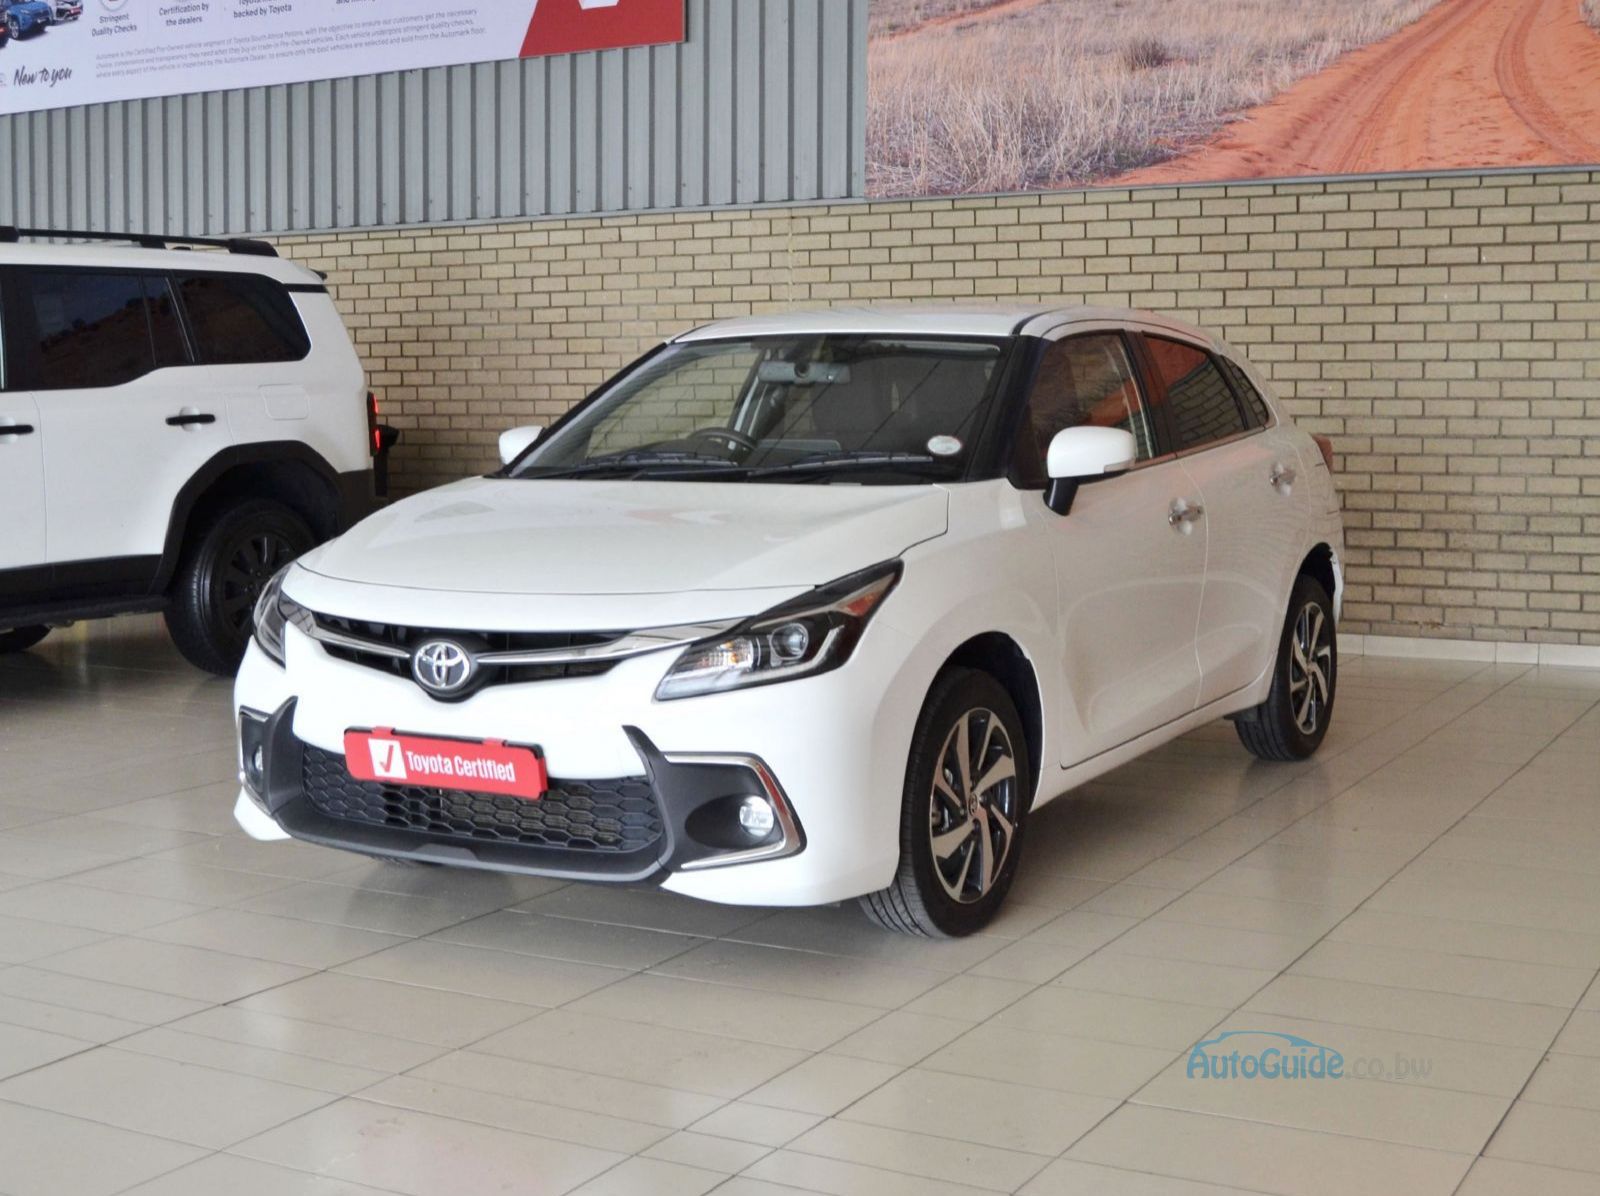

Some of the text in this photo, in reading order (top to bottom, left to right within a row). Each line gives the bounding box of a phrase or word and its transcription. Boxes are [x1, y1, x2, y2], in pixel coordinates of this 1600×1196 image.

[159, 2, 209, 16] Certification by
[233, 4, 292, 18] backed by Toyota
[99, 13, 129, 24] Stringent
[178, 16, 202, 25] dealers
[91, 24, 137, 37] Quality Checks
[13, 65, 37, 86] New
[38, 67, 49, 83] to
[50, 67, 72, 87] you
[406, 751, 516, 782] Toyota Certified
